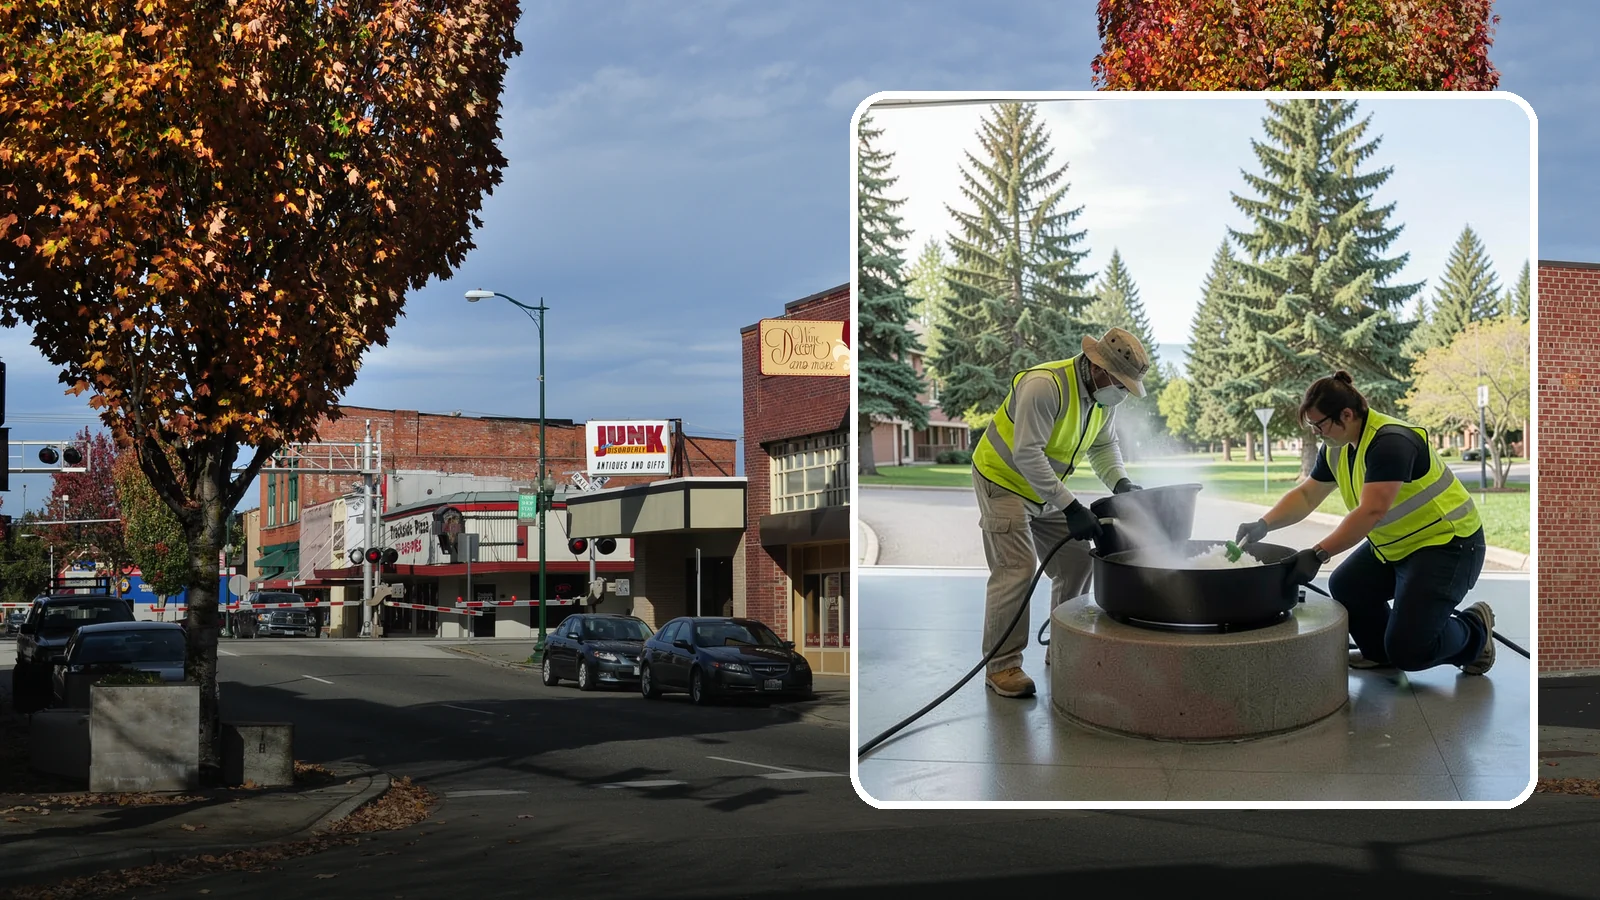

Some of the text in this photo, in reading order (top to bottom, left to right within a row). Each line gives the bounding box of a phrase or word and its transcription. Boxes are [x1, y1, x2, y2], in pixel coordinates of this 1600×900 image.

[595, 425, 666, 457] JUNK
[597, 460, 665, 470] ANTIQUES AND GIFTS
[390, 519, 429, 540] Trackside Pizza
